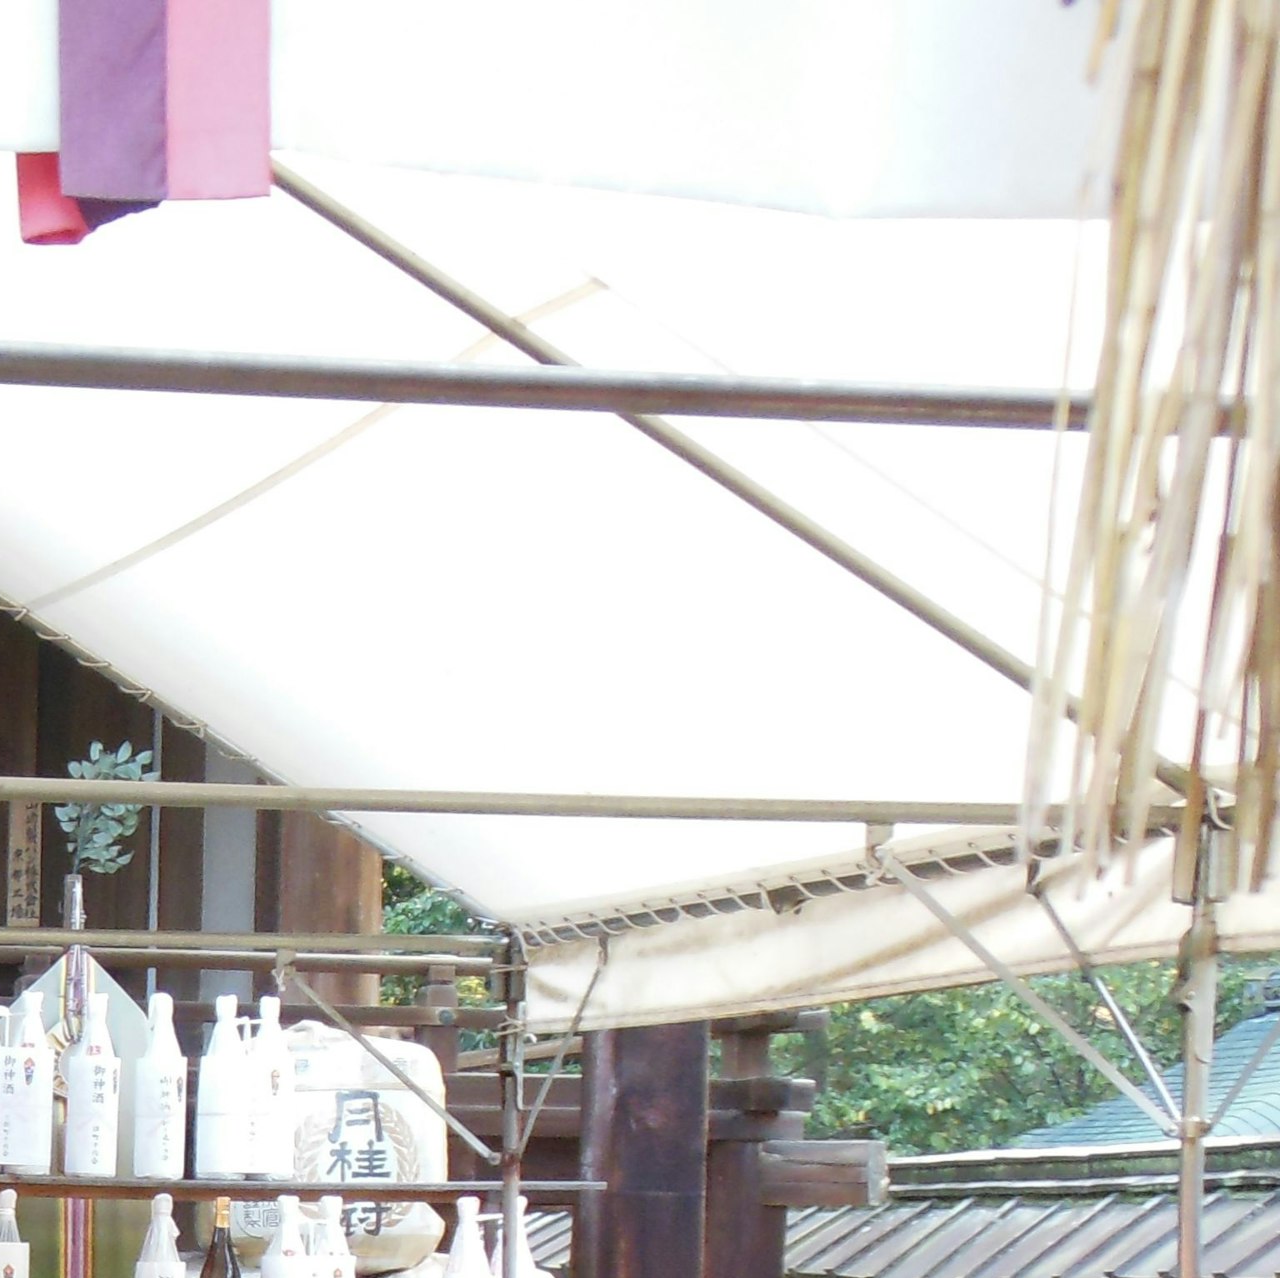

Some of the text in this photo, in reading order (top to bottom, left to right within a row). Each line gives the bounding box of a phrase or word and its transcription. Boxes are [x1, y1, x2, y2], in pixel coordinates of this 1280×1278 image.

[3, 1055, 17, 1095] 御神酒
[92, 1065, 106, 1104] 御神酒
